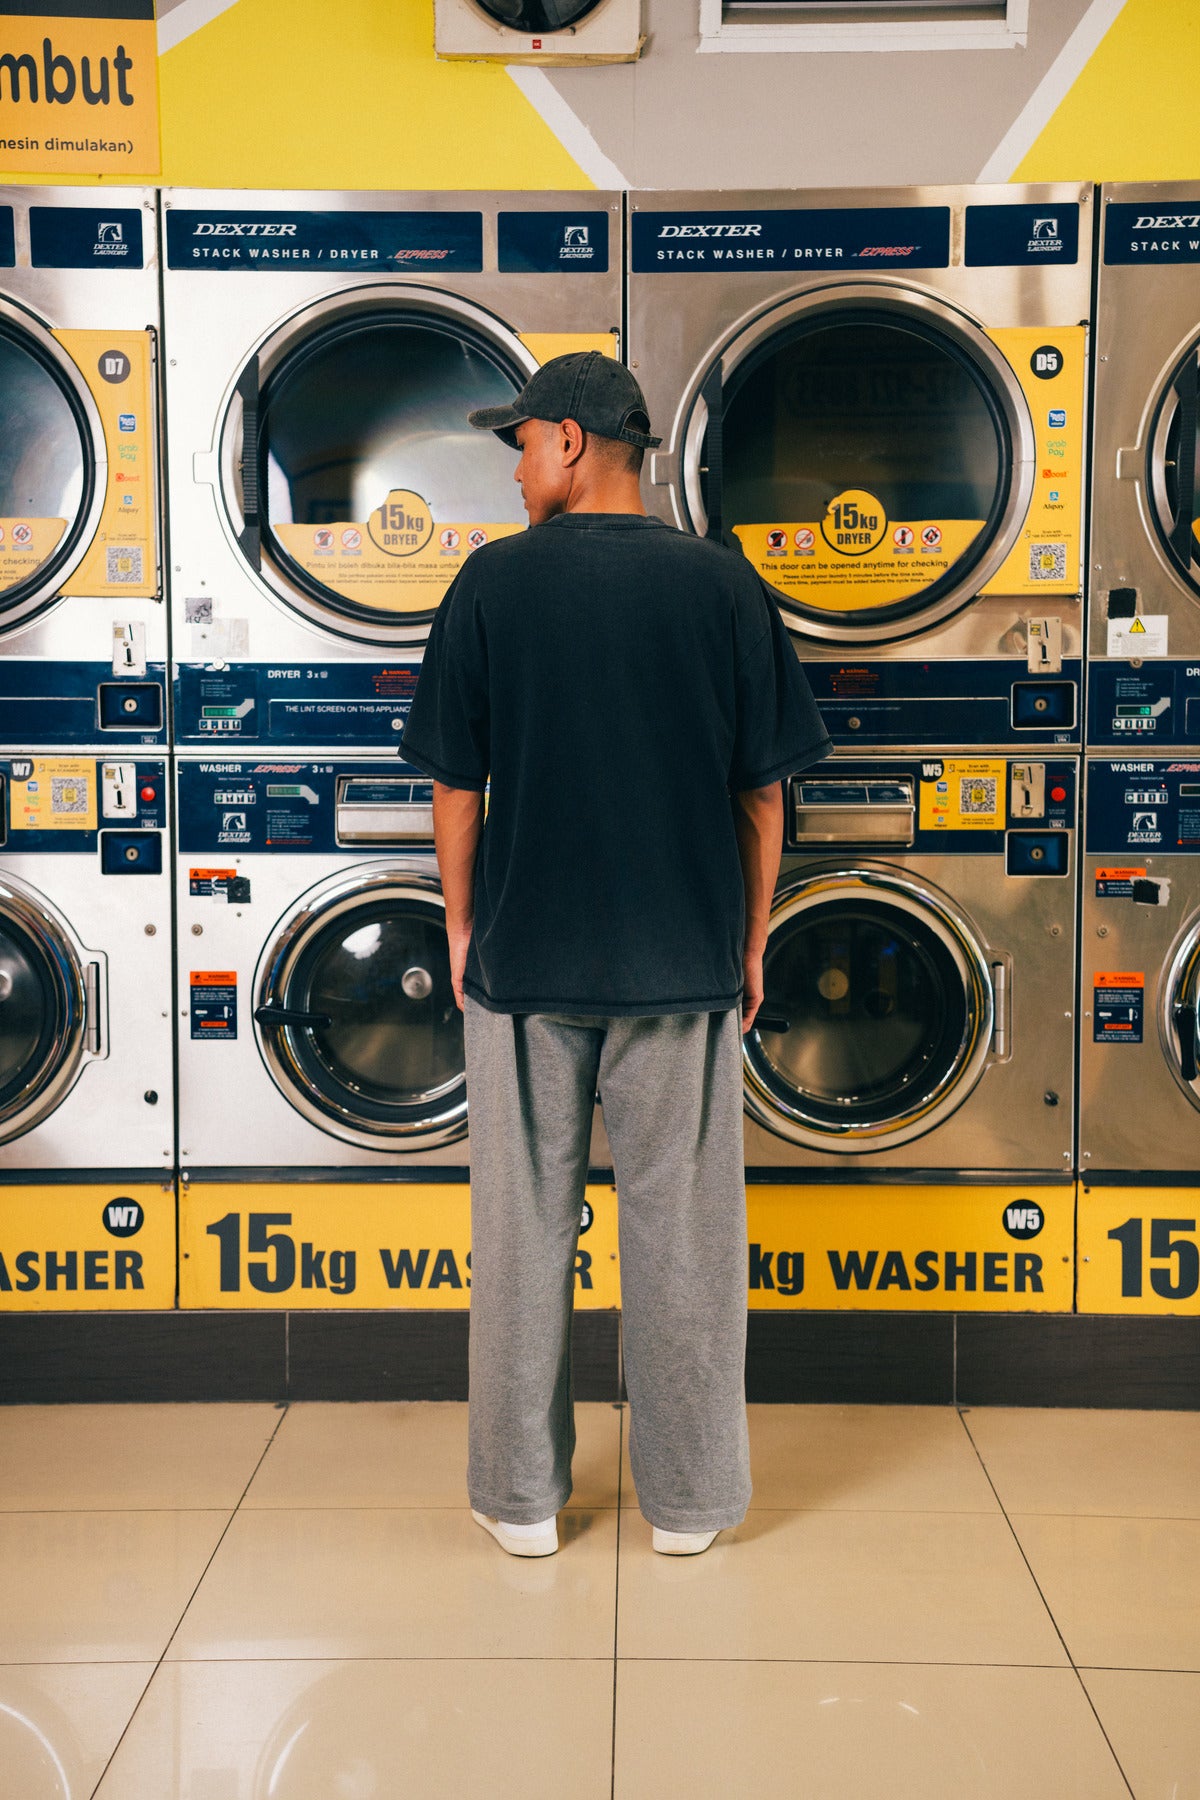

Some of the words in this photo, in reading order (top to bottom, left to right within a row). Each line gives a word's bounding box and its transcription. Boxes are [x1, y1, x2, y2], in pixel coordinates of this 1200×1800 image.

[45, 137, 134, 154] dimulakan)
[193, 223, 297, 236] DEXTER
[658, 224, 762, 238] DEXTER
[1131, 241, 1180, 251] STACK
[192, 248, 241, 258] STACK
[249, 248, 310, 259] WASHER
[330, 249, 379, 259] DRYER
[657, 250, 705, 260] STACK
[713, 249, 775, 259] WASHER
[794, 248, 843, 258] DRYER
[105, 357, 123, 376] D7
[1036, 353, 1057, 371] D5
[377, 504, 424, 532] 15kg
[832, 503, 877, 531] 15kg
[384, 533, 418, 546] DRYER
[837, 532, 871, 545] DRYER
[830, 562, 861, 571] opened
[863, 561, 895, 570] anytime
[897, 560, 909, 568] for
[911, 560, 948, 569] checking
[267, 670, 300, 679] DRYER
[307, 670, 313, 679] 3
[317, 705, 345, 713] SCREEN
[347, 705, 358, 713] ON
[360, 705, 375, 713] THIS
[12, 762, 31, 777] W7
[199, 764, 242, 773] WASHER
[312, 765, 318, 773] 3
[922, 763, 942, 777] W5
[1110, 763, 1154, 772] WASHER
[108, 1206, 139, 1228] W7
[1006, 1207, 1039, 1230] W5
[206, 1212, 357, 1295] 15kg
[1107, 1218, 1200, 1300] 15
[827, 1250, 1044, 1293] WASHER
